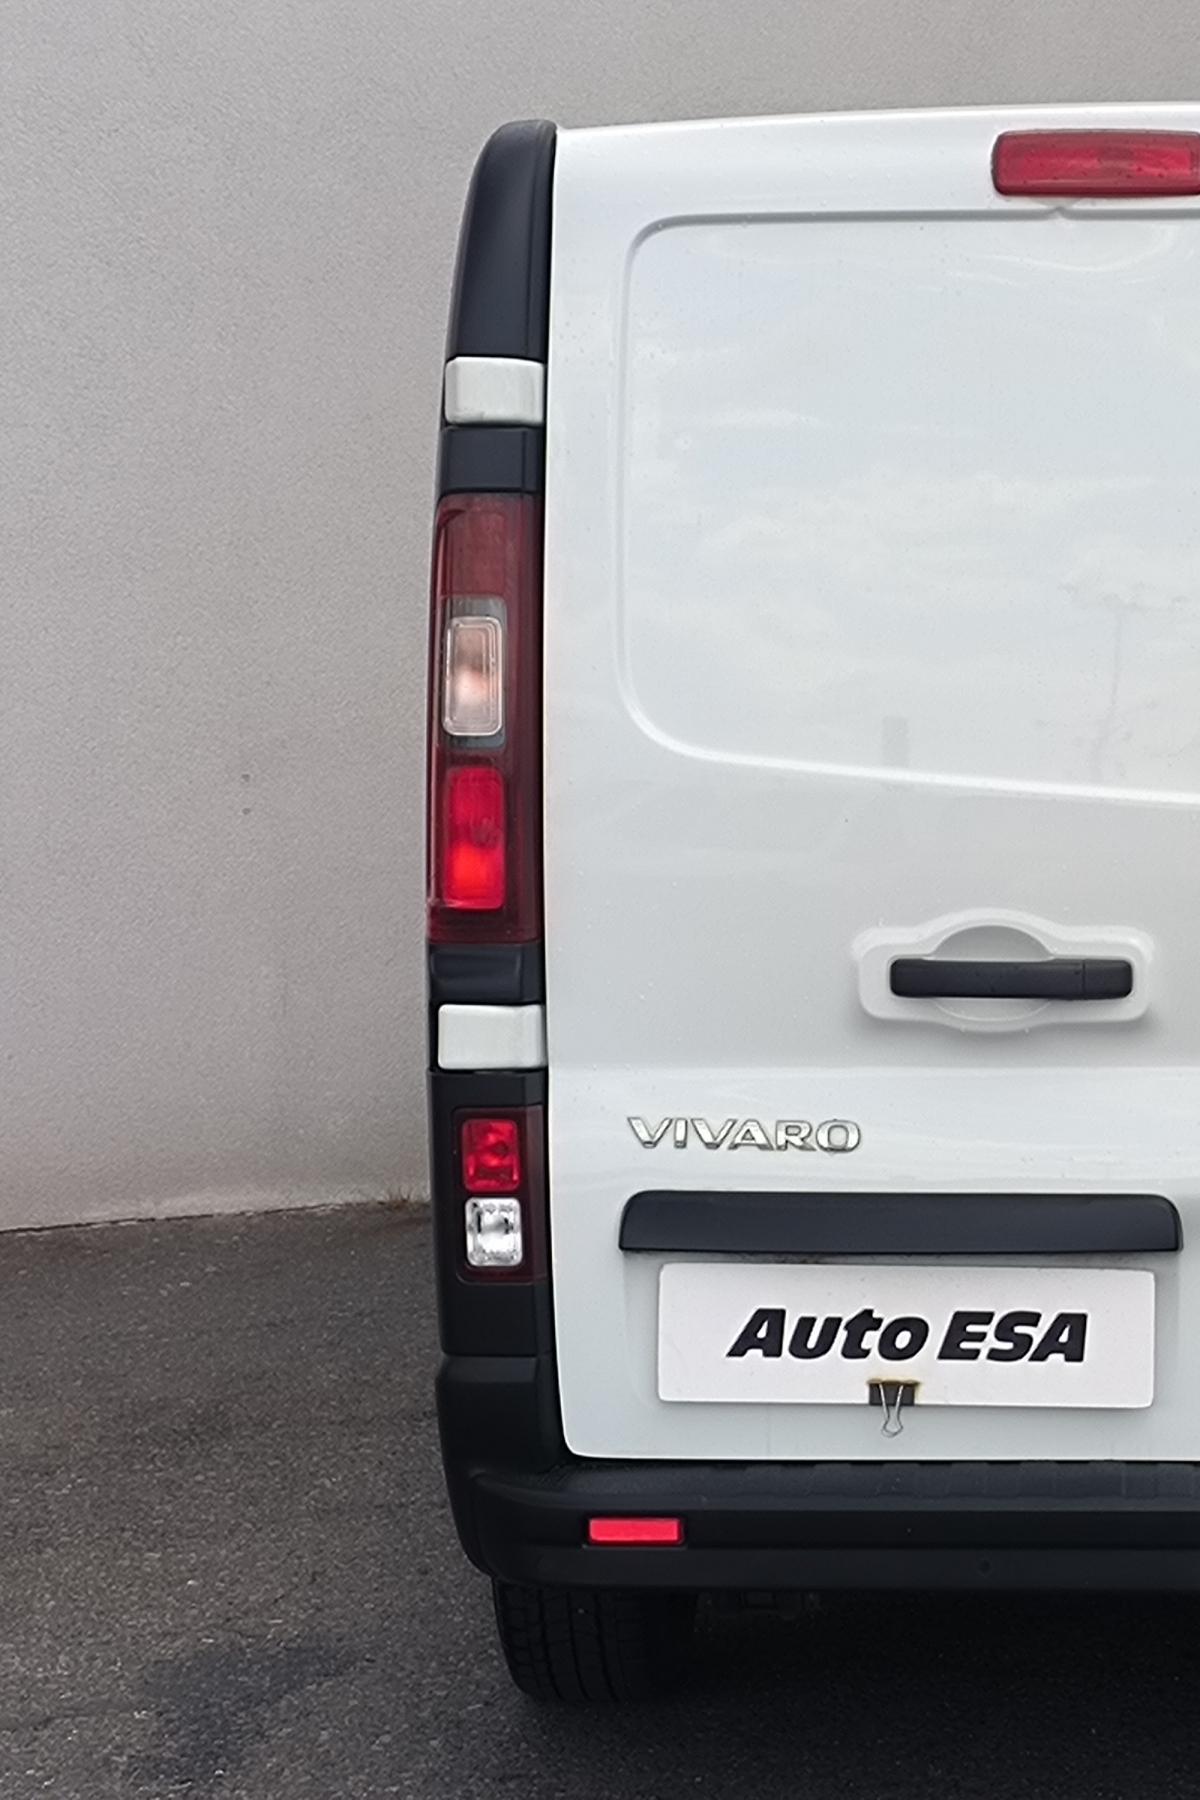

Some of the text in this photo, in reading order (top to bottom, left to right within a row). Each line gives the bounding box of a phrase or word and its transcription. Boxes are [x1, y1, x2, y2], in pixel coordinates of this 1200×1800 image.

[627, 1116, 862, 1154] VIVARO
[726, 1307, 1088, 1363] Auto ESA
